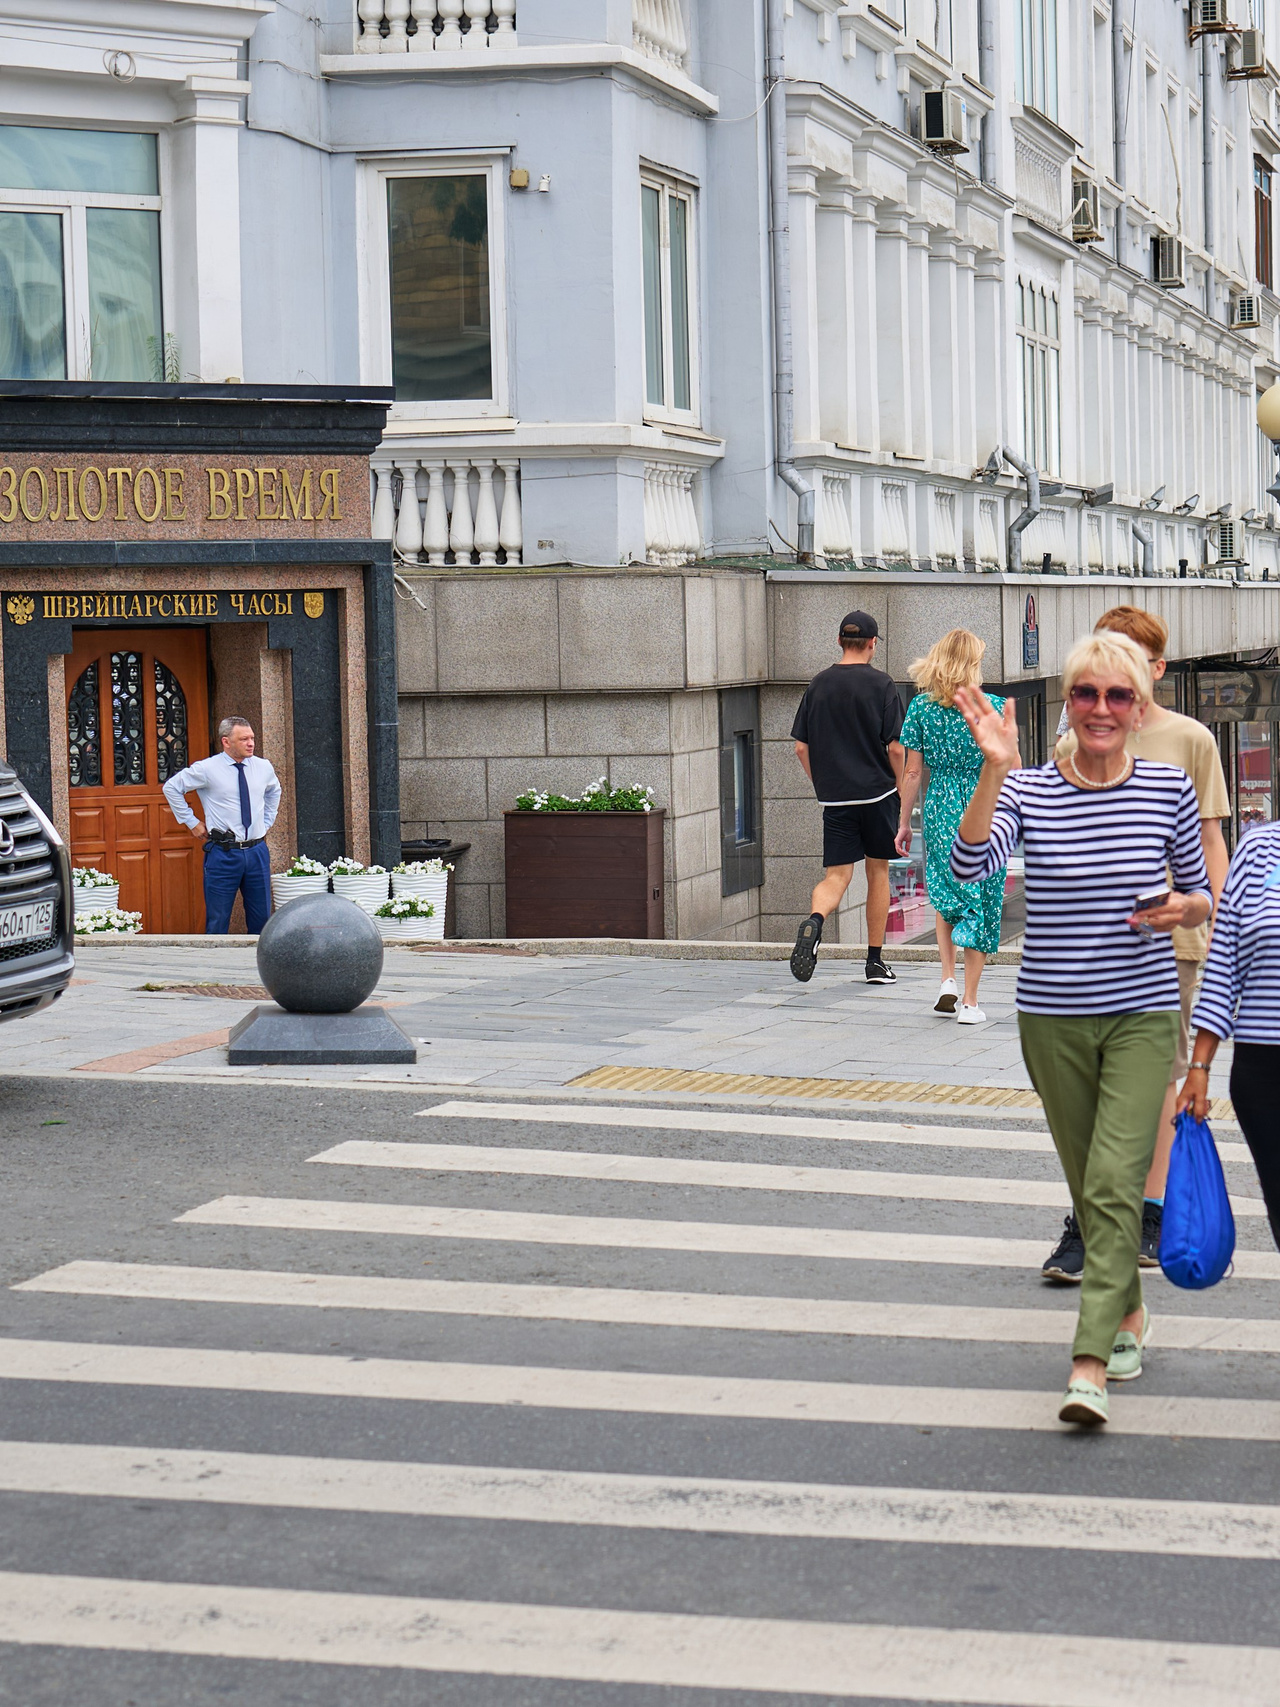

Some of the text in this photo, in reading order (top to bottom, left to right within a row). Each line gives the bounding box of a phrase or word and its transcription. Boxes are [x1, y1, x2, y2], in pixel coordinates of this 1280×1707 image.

[0, 466, 343, 523] ЗОЛОТОЕ ВРЕМЯ
[42, 591, 293, 619] ШВЕЙЦАРСКИЕ ЧАСЫ
[35, 903, 51, 924] 125
